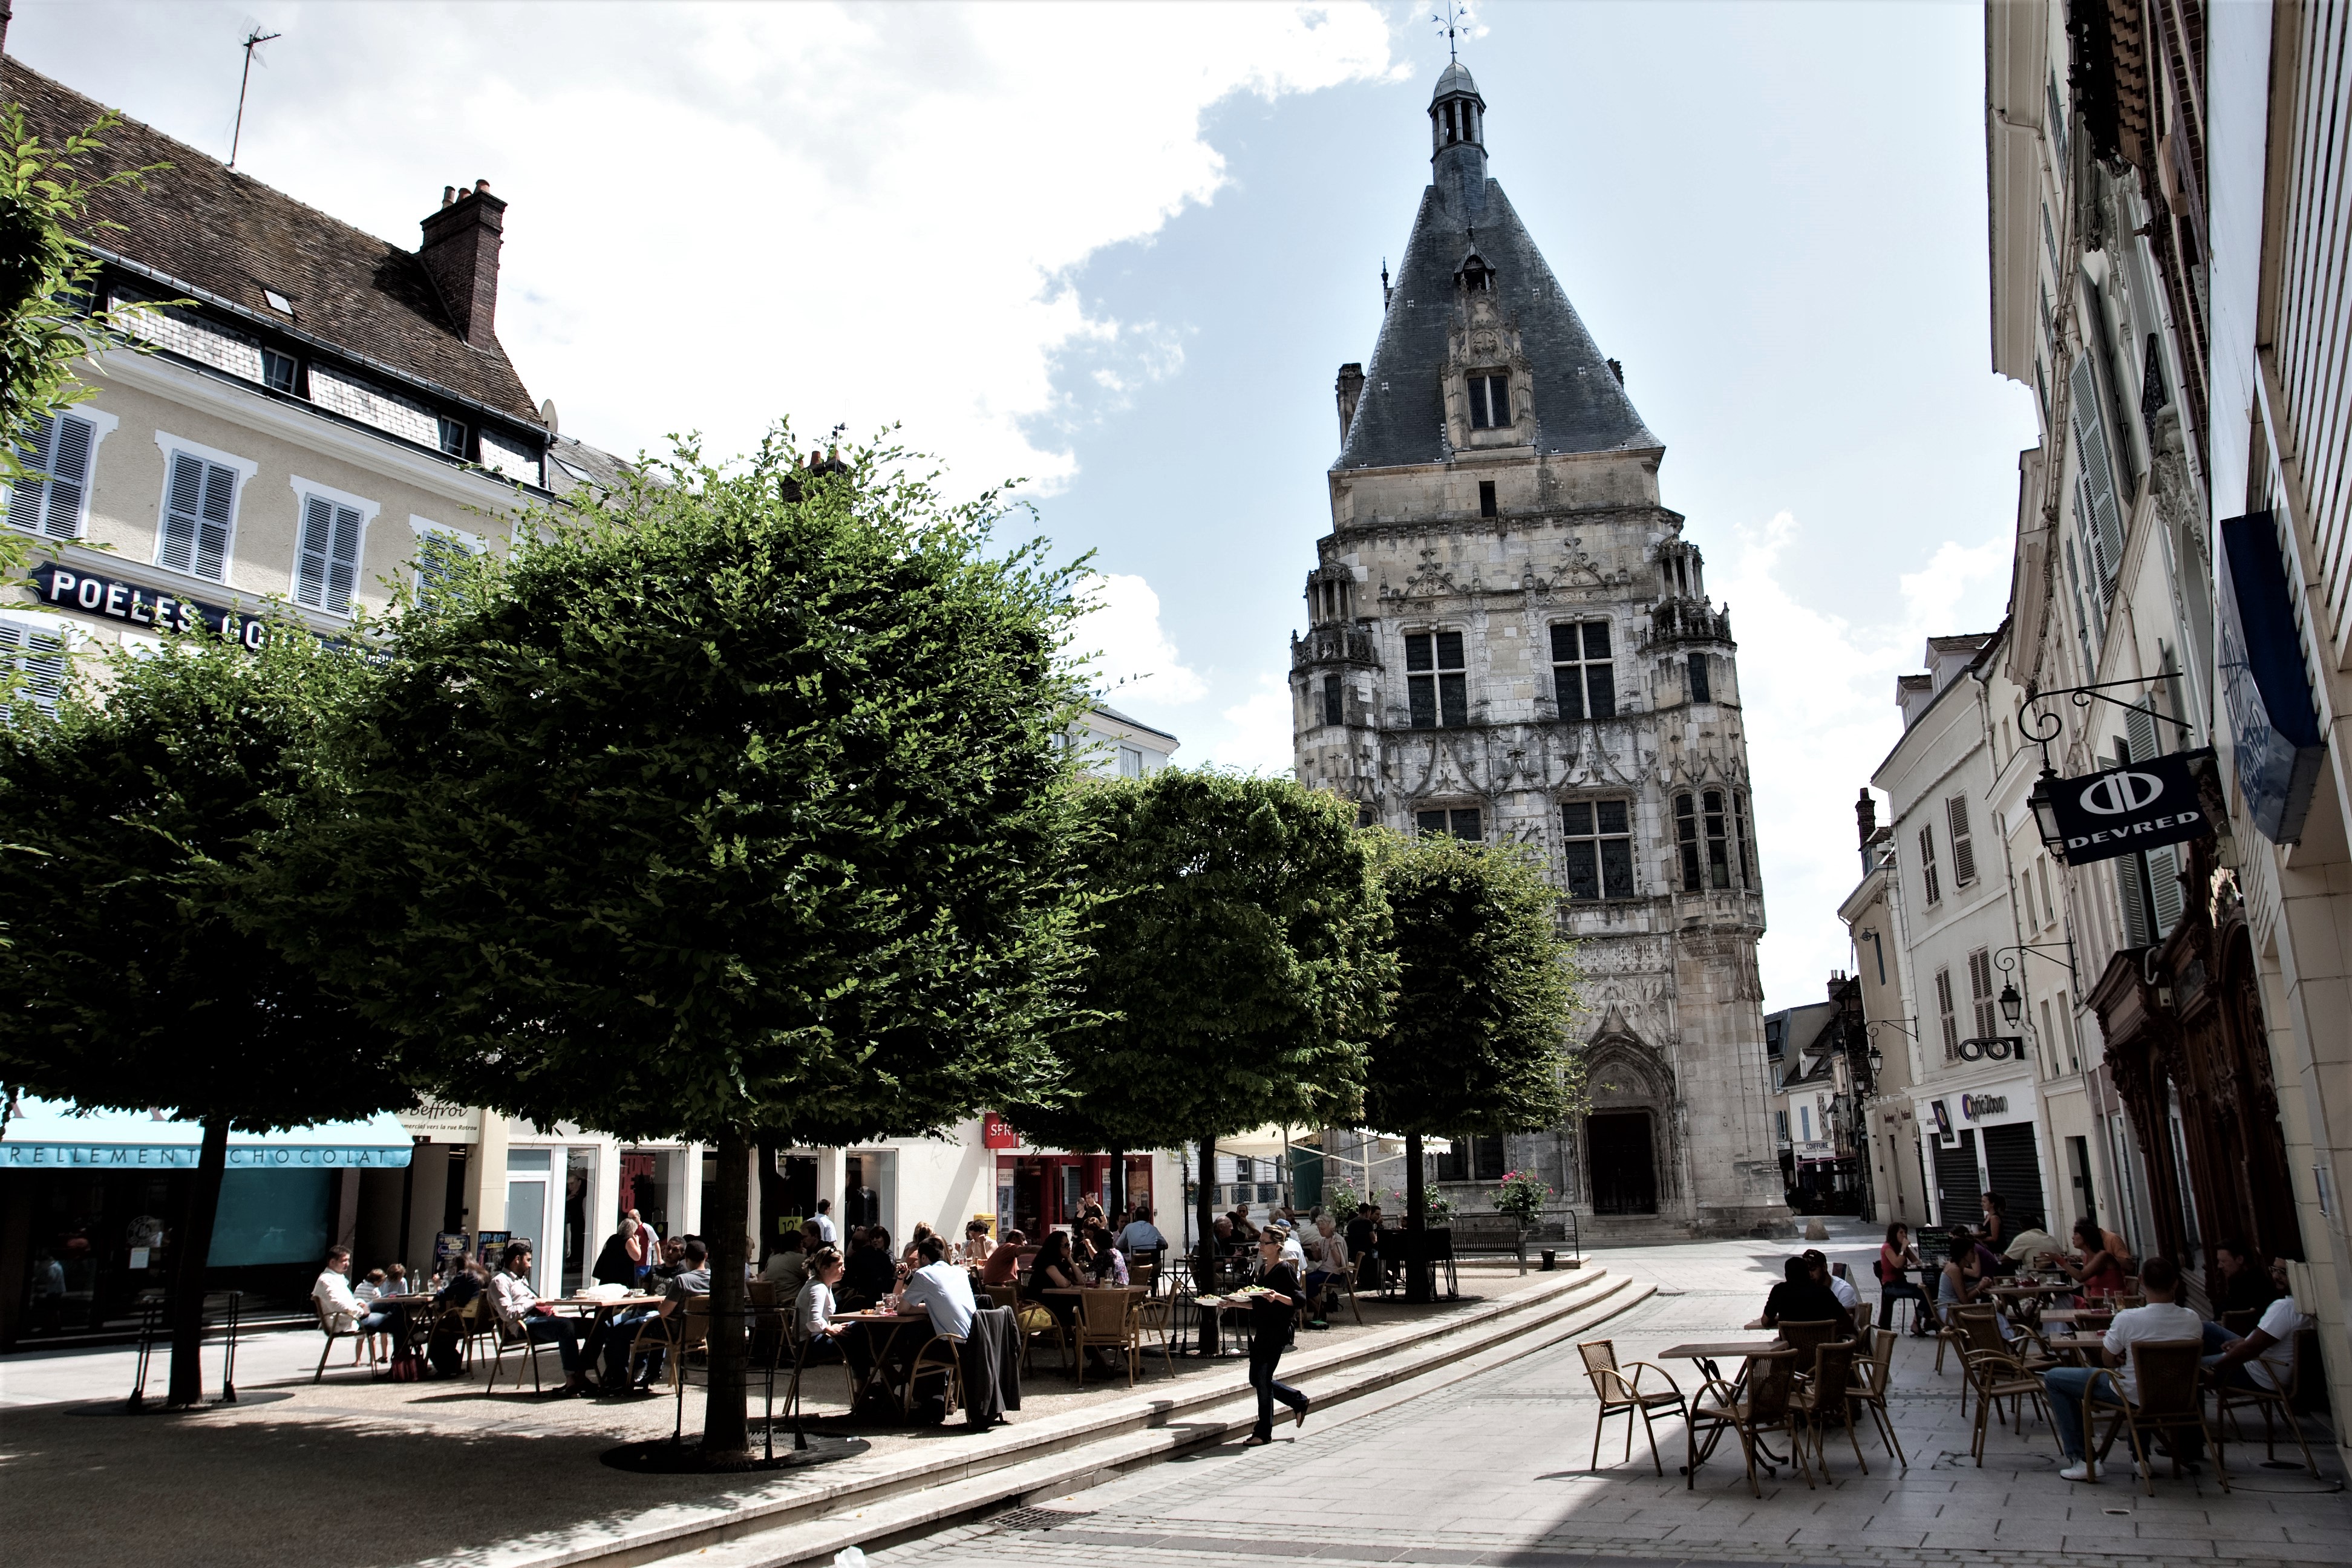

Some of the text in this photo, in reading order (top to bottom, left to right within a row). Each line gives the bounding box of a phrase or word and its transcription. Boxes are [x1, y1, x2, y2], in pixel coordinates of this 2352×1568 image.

[2068, 811, 2200, 849] DEVRED
[990, 1123, 1011, 1136] SFR
[10, 1146, 386, 1164] RELLEMENT CHOCOLAT
